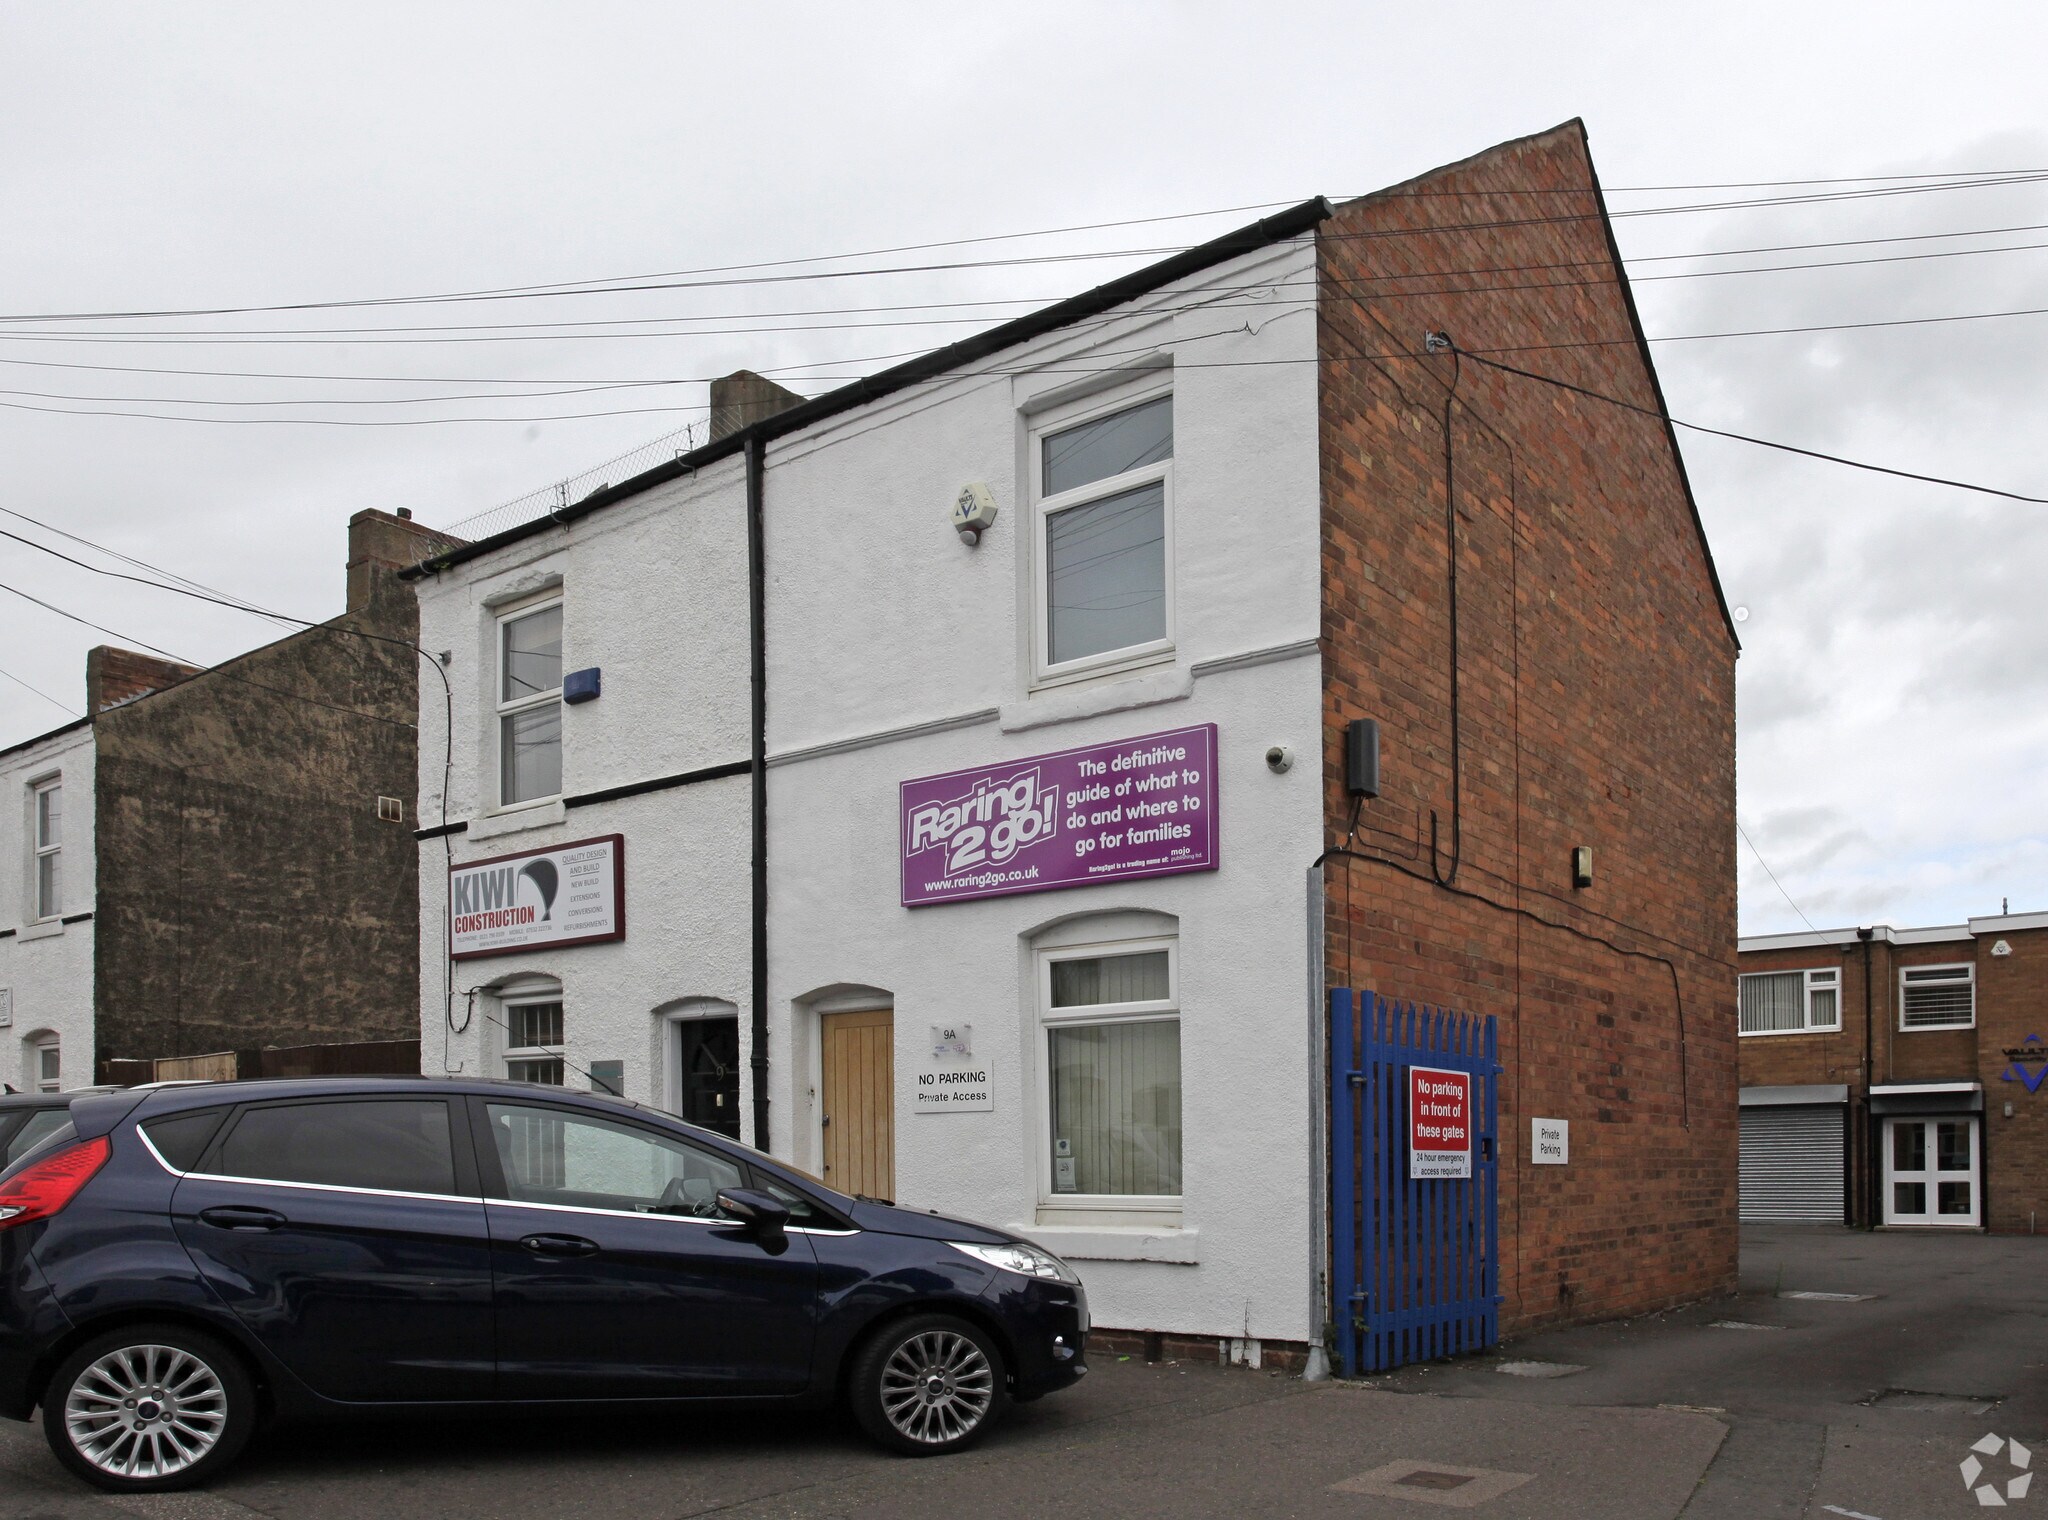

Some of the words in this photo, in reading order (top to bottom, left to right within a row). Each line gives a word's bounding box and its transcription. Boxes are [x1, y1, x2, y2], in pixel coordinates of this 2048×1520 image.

[1078, 760, 1106, 777] The
[1111, 746, 1186, 772] definitive
[1066, 783, 1110, 809] guide
[1115, 777, 1131, 796] of
[1135, 771, 1178, 793] what
[1182, 769, 1200, 785] to
[912, 776, 1035, 850] Raring
[1066, 812, 1086, 829] do
[1091, 805, 1121, 825] and
[1126, 801, 1178, 820] where
[1182, 795, 1200, 811] to
[1075, 839, 1095, 857] go
[1099, 832, 1123, 849] for
[1127, 822, 1191, 845] families
[562, 852, 586, 863] QUALITY
[587, 848, 607, 859] DESIGN
[1171, 847, 1191, 856] mojo
[1171, 854, 1195, 862] publishing
[570, 865, 582, 875] AND
[583, 863, 600, 872] BUILD
[571, 880, 583, 888] NEW
[584, 878, 599, 887] BUILD
[925, 865, 1039, 892] www.raring2go.co.uk
[454, 867, 515, 915] KIWI
[570, 892, 600, 902] EXTENSIONS
[568, 906, 603, 917] CONVERSIONS
[455, 905, 535, 934] CONSTRUCTION
[564, 919, 608, 931] REFURBISHMENTS
[943, 1029, 956, 1040] 9A
[716, 1065, 724, 1081] 9
[919, 1074, 934, 1085] NO
[939, 1071, 986, 1084] PARKING
[1418, 1079, 1431, 1094] No
[1432, 1081, 1463, 1100] parking
[918, 1092, 949, 1102] Private
[952, 1092, 987, 1101] Access
[1420, 1101, 1429, 1116] in
[1430, 1101, 1451, 1117] front
[1452, 1103, 1462, 1118] of
[1417, 1123, 1441, 1139] these
[1442, 1126, 1465, 1142] gates
[1541, 1128, 1560, 1140] Private
[1540, 1143, 1561, 1157] Parking
[1416, 1153, 1423, 1162] 24
[1424, 1153, 1437, 1162] hour
[1437, 1154, 1466, 1164] emergency
[1421, 1167, 1440, 1176] access
[1440, 1166, 1462, 1178] required
